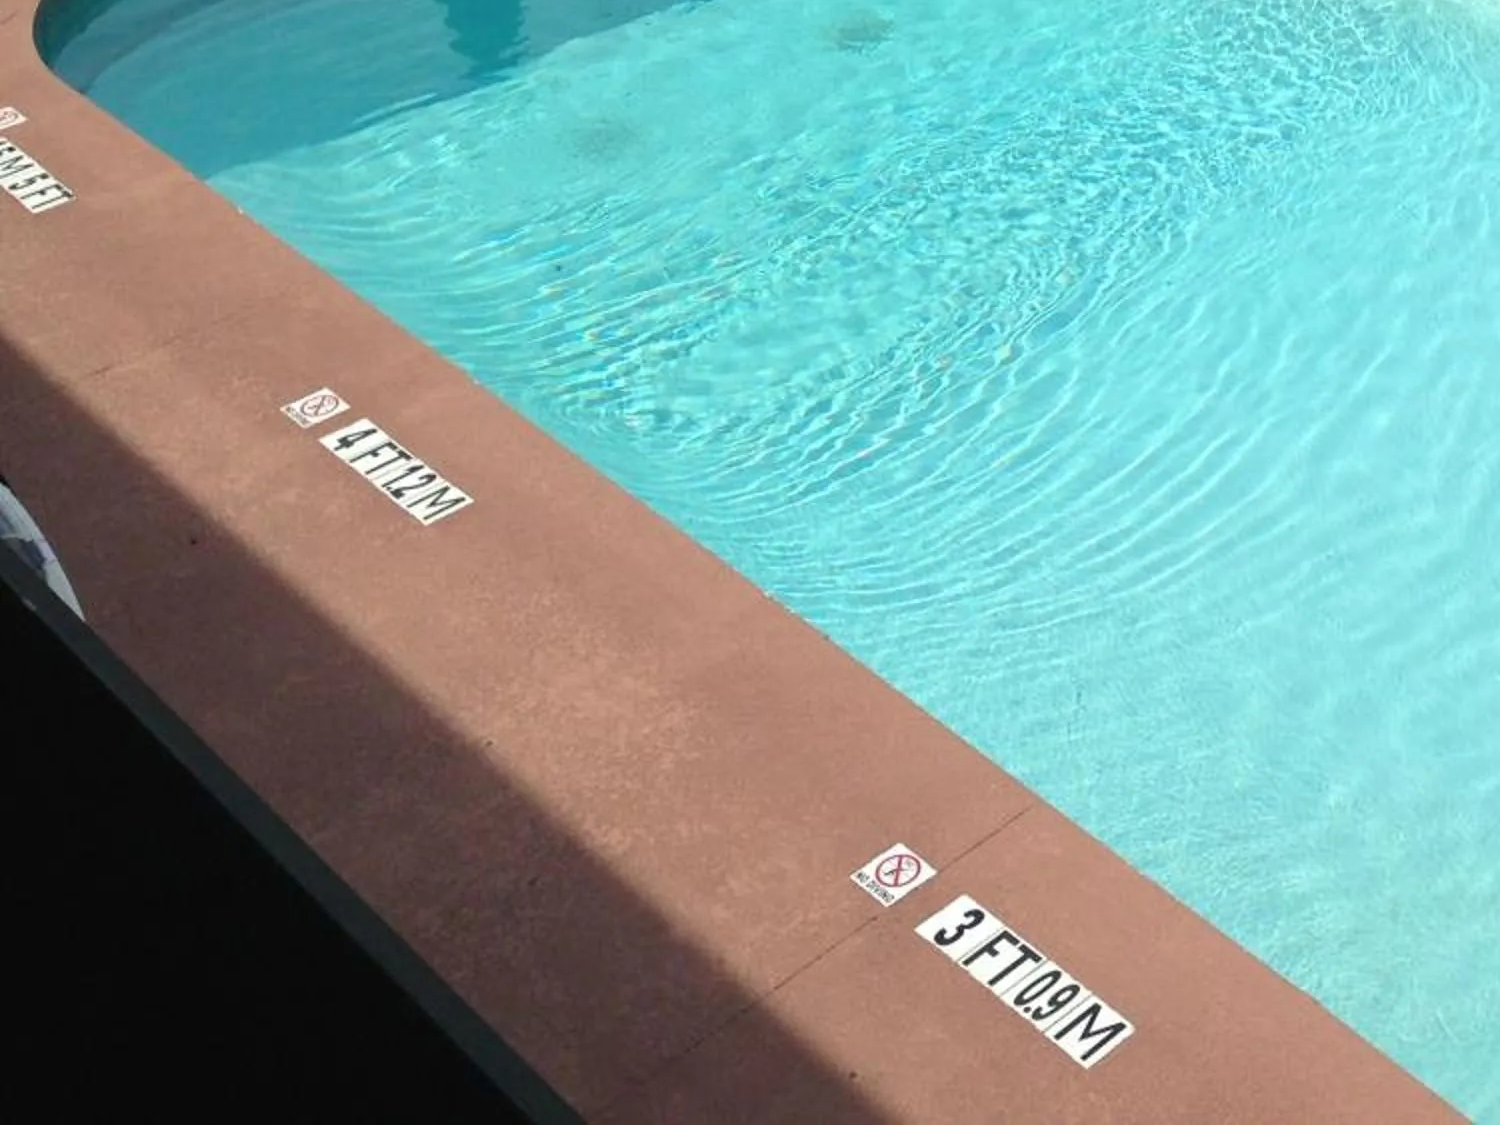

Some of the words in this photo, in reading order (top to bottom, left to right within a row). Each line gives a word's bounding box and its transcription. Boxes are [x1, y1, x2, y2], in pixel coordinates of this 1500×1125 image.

[8, 173, 49, 190] 5
[333, 428, 378, 451] 4
[350, 441, 413, 475] FT
[406, 485, 466, 520] M
[933, 909, 985, 945] 3
[962, 930, 1042, 987] FT
[1053, 1002, 1127, 1061] M
